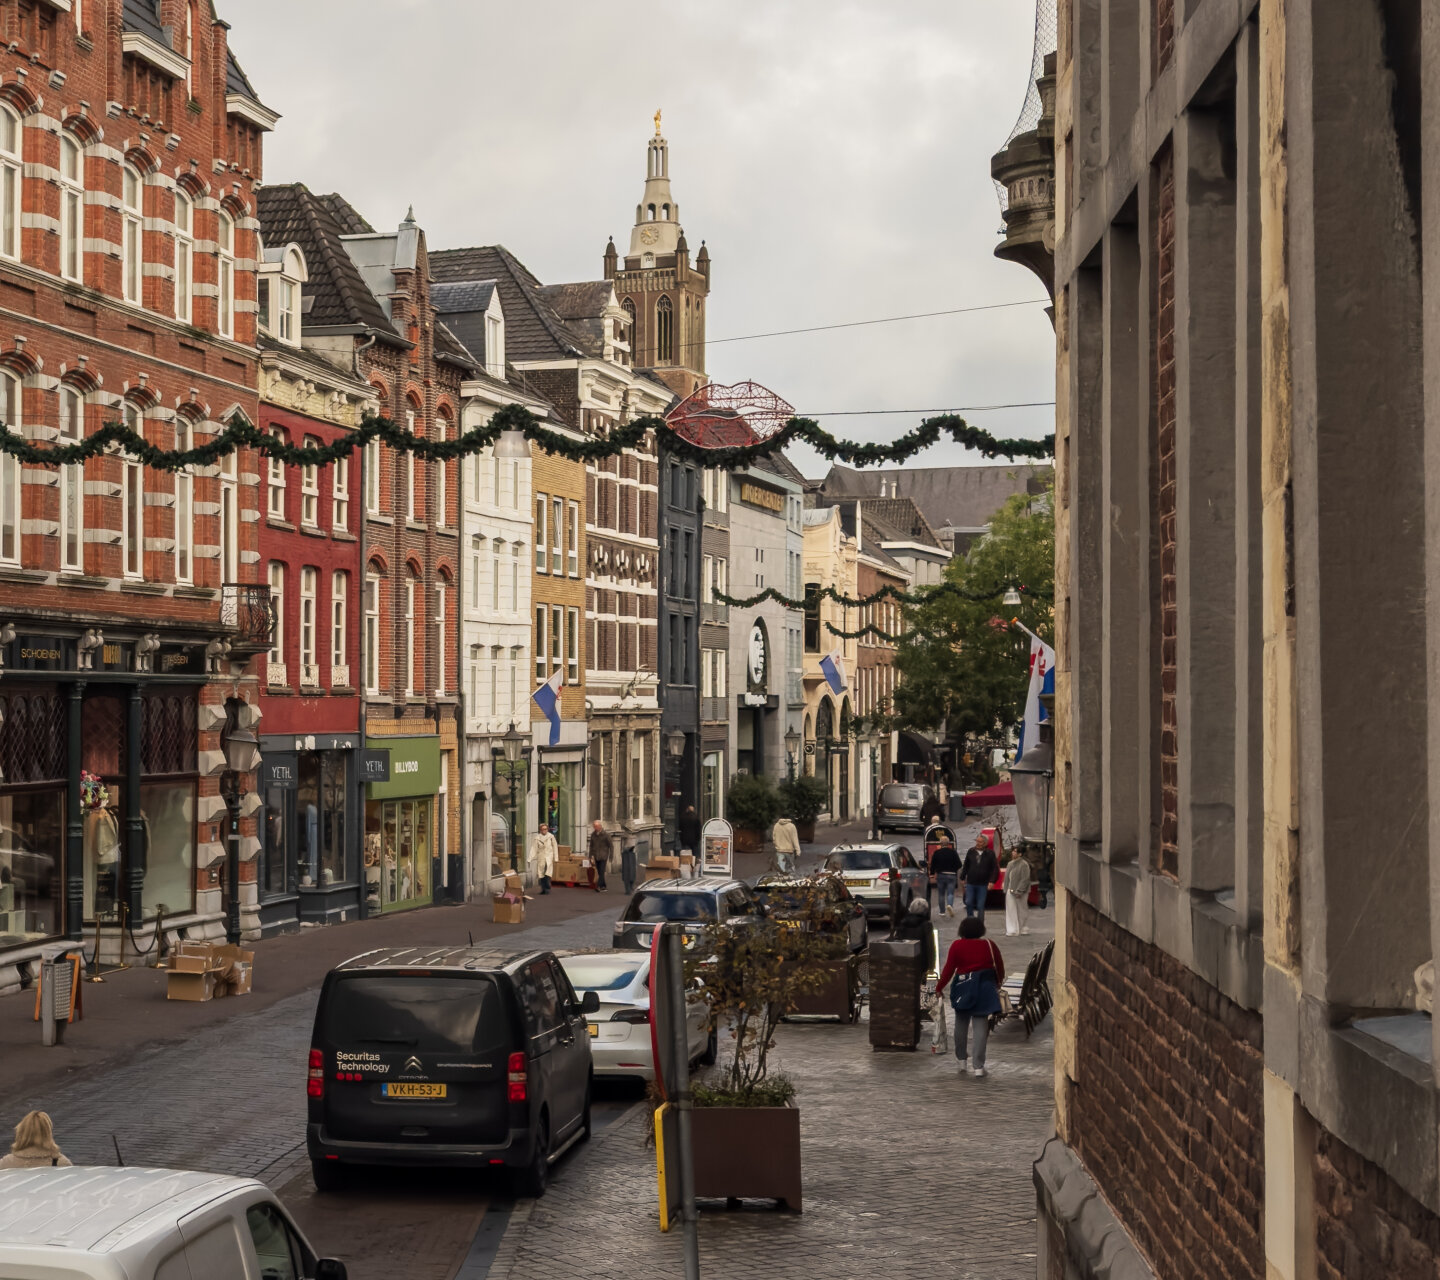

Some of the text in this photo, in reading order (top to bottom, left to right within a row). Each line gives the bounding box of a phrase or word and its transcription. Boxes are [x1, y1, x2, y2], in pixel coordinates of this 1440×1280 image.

[336, 1051, 380, 1061] Securitas
[336, 1061, 390, 1073] Technology
[392, 1084, 443, 1096] VKH-53-J
